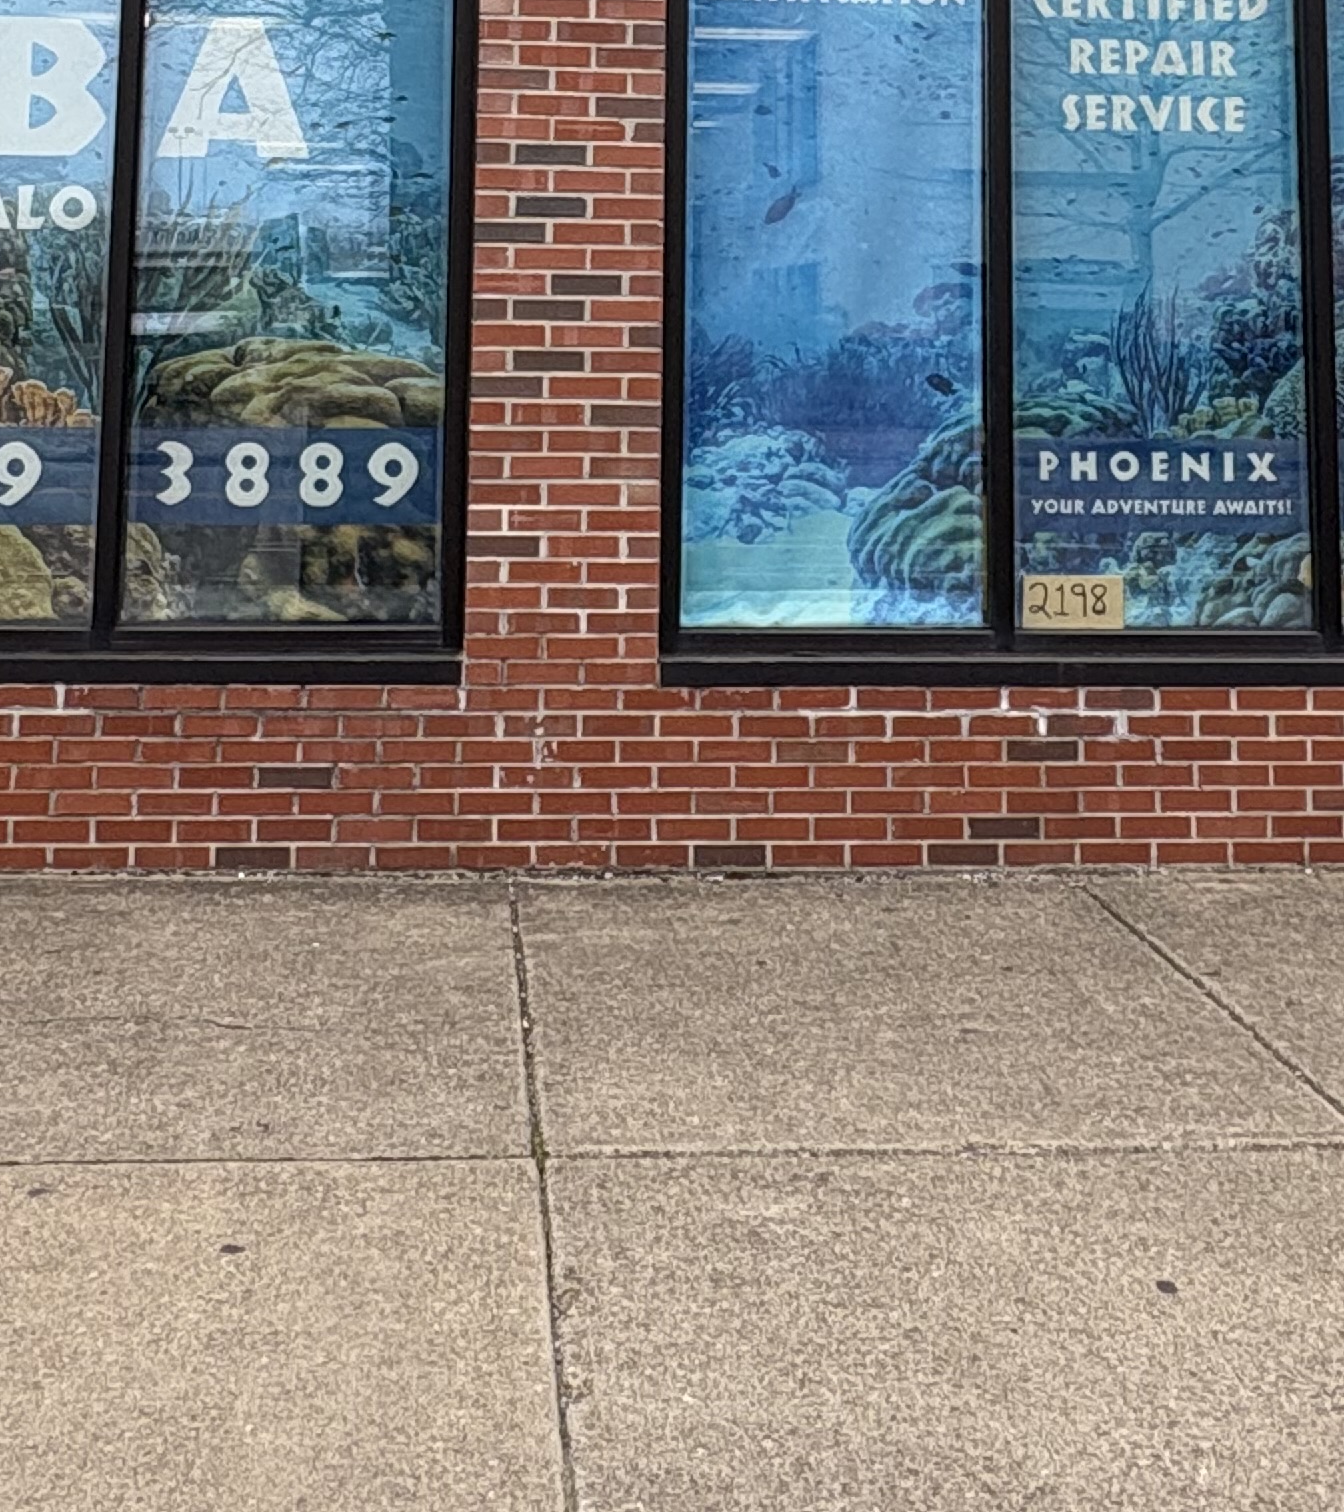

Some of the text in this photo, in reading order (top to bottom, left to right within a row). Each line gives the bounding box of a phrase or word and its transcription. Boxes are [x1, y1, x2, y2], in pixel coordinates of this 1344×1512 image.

[1069, 38, 1237, 77] REPAIR
[1062, 94, 1247, 133] SERVICE
[155, 440, 420, 507] 3889
[1039, 450, 1278, 483] PHOENIX
[1031, 499, 1293, 516] YOUR ADVENTURE AWAITS!
[1029, 582, 1108, 619] 2198
